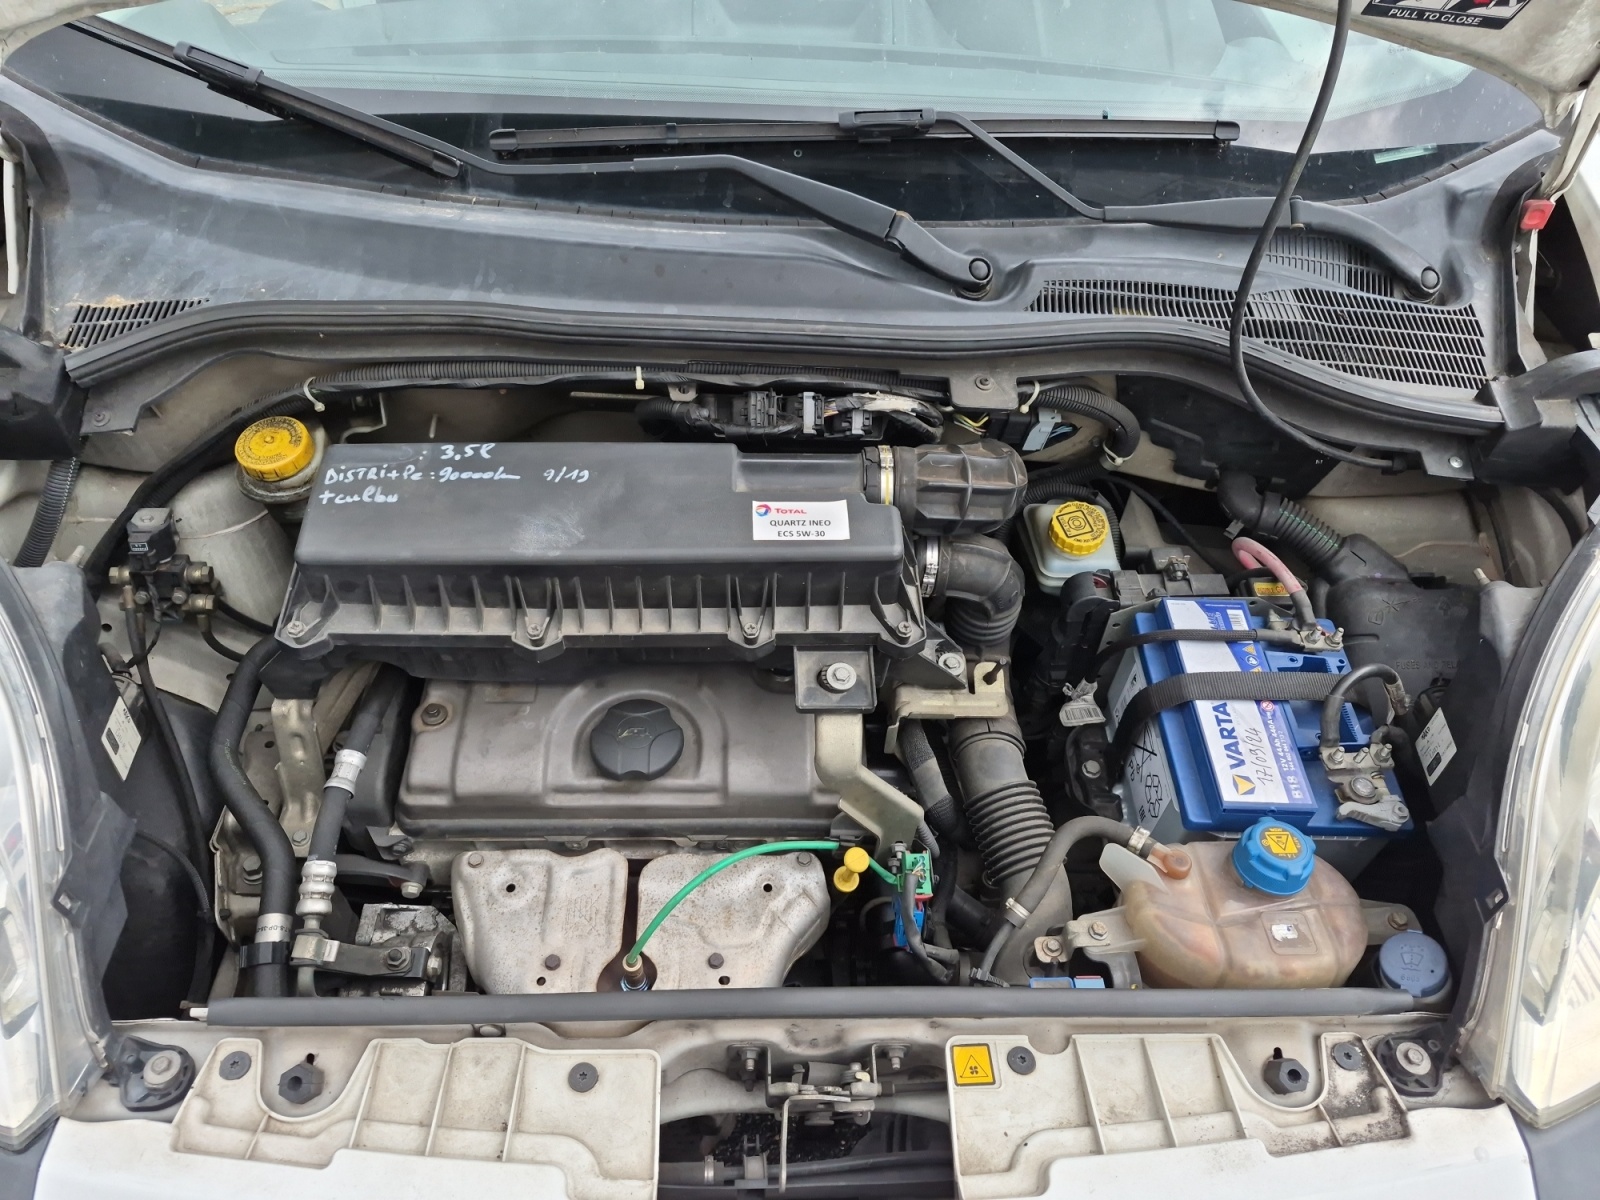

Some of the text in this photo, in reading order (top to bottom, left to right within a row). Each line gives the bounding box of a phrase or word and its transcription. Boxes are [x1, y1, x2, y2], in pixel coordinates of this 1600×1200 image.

[1388, 8, 1483, 25] PULL TO CLOSE
[769, 519, 831, 527] QUARTZ INEO
[1212, 702, 1246, 770] VARTA
[1280, 758, 1289, 771] 12V
[1286, 775, 1305, 799] B18
